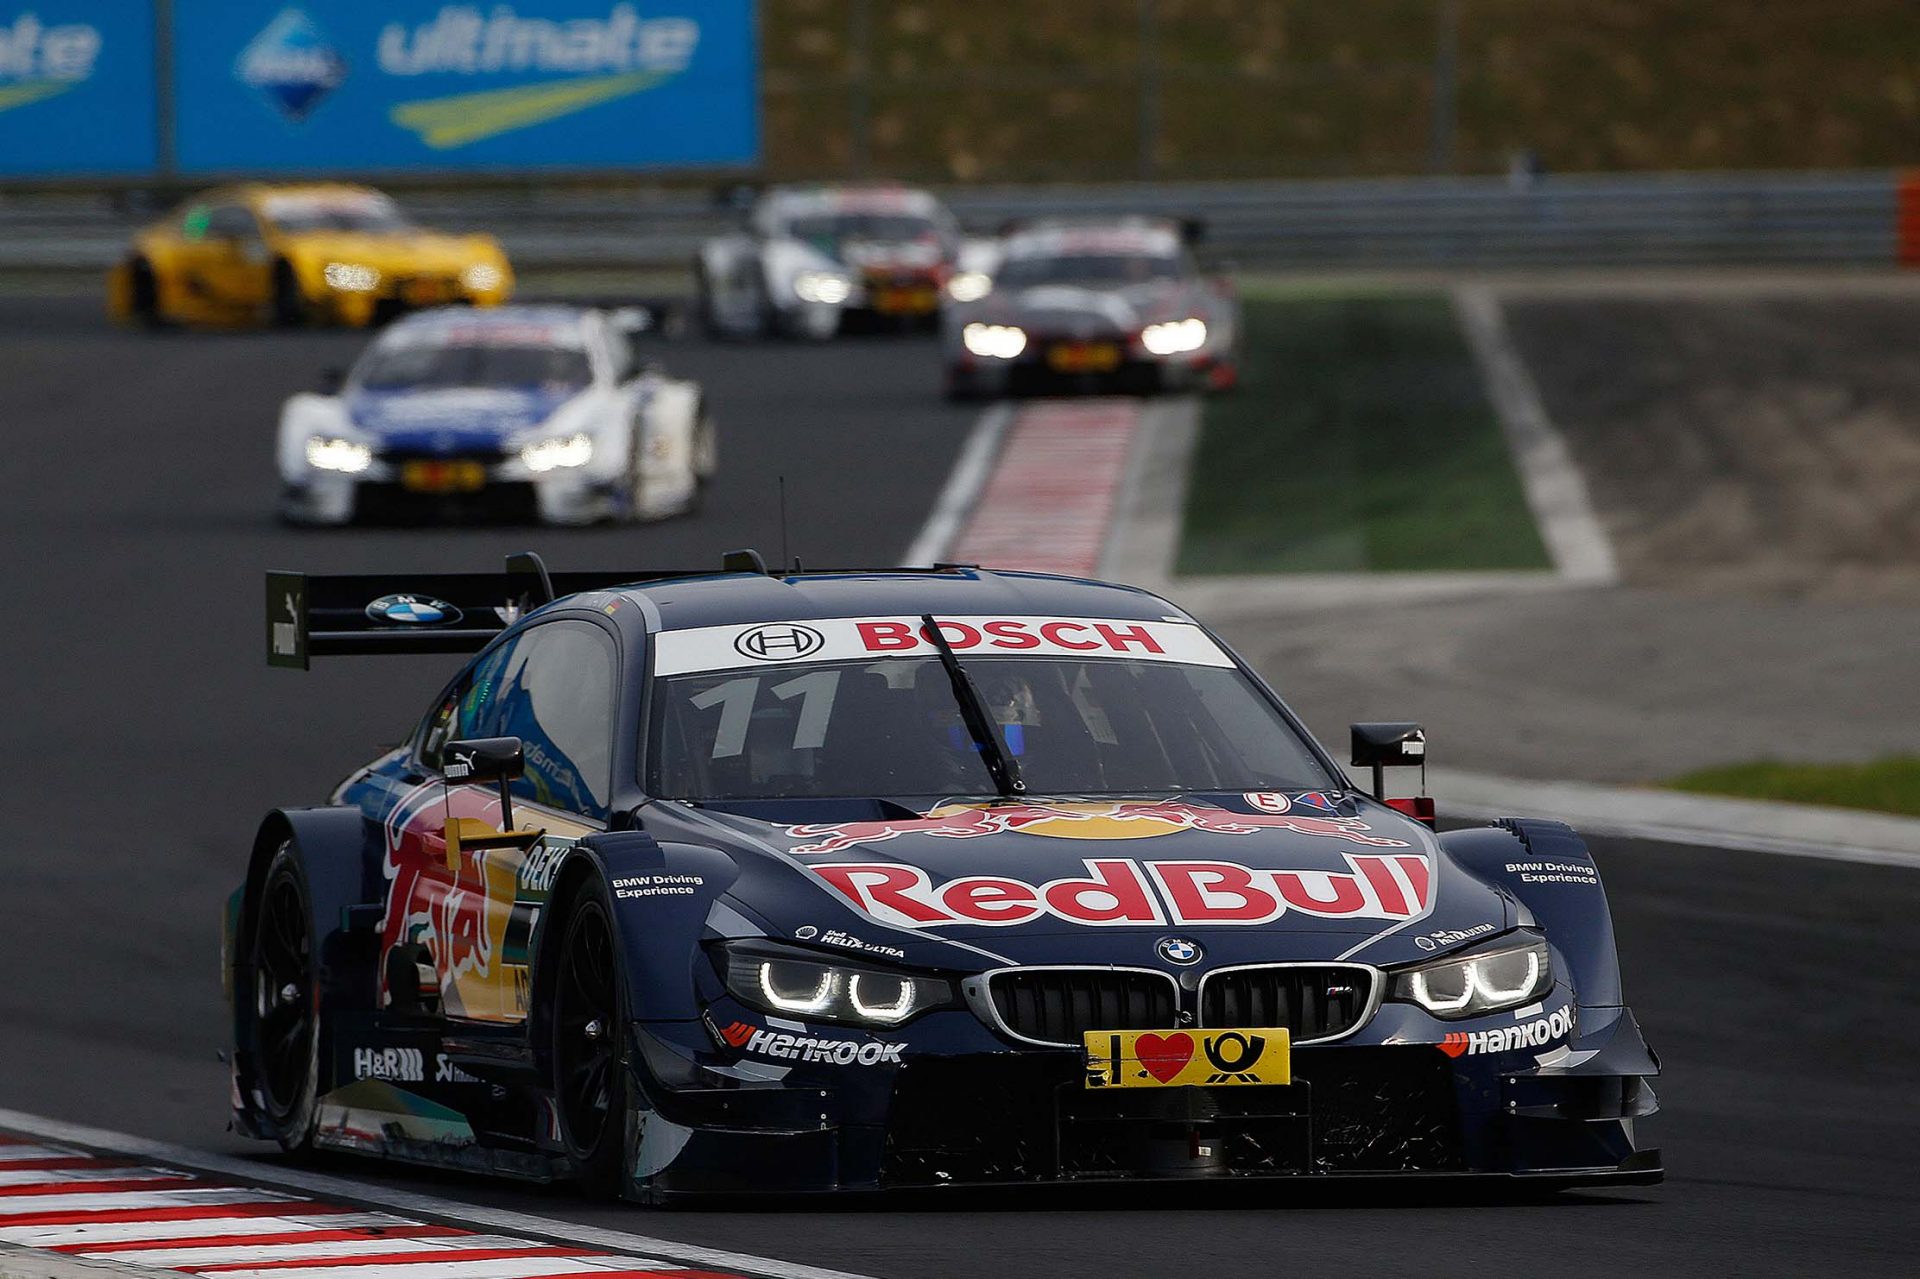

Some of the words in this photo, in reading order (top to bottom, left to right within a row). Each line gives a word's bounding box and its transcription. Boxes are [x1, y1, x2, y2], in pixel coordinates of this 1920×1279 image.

[378, 4, 700, 76] ultimate
[856, 621, 1165, 654] BOSCH
[689, 671, 842, 759] 11
[1505, 863, 1542, 872] BMW
[1544, 862, 1594, 875] Driving
[612, 876, 650, 888] BMW
[652, 874, 703, 886] Driving
[1521, 873, 1597, 884] Experience
[616, 886, 695, 898] Experience
[807, 857, 1168, 927] Red
[1147, 852, 1433, 926] Bull
[826, 930, 847, 938] Shell
[820, 935, 863, 949] HELIX
[864, 943, 905, 958] ULTRA
